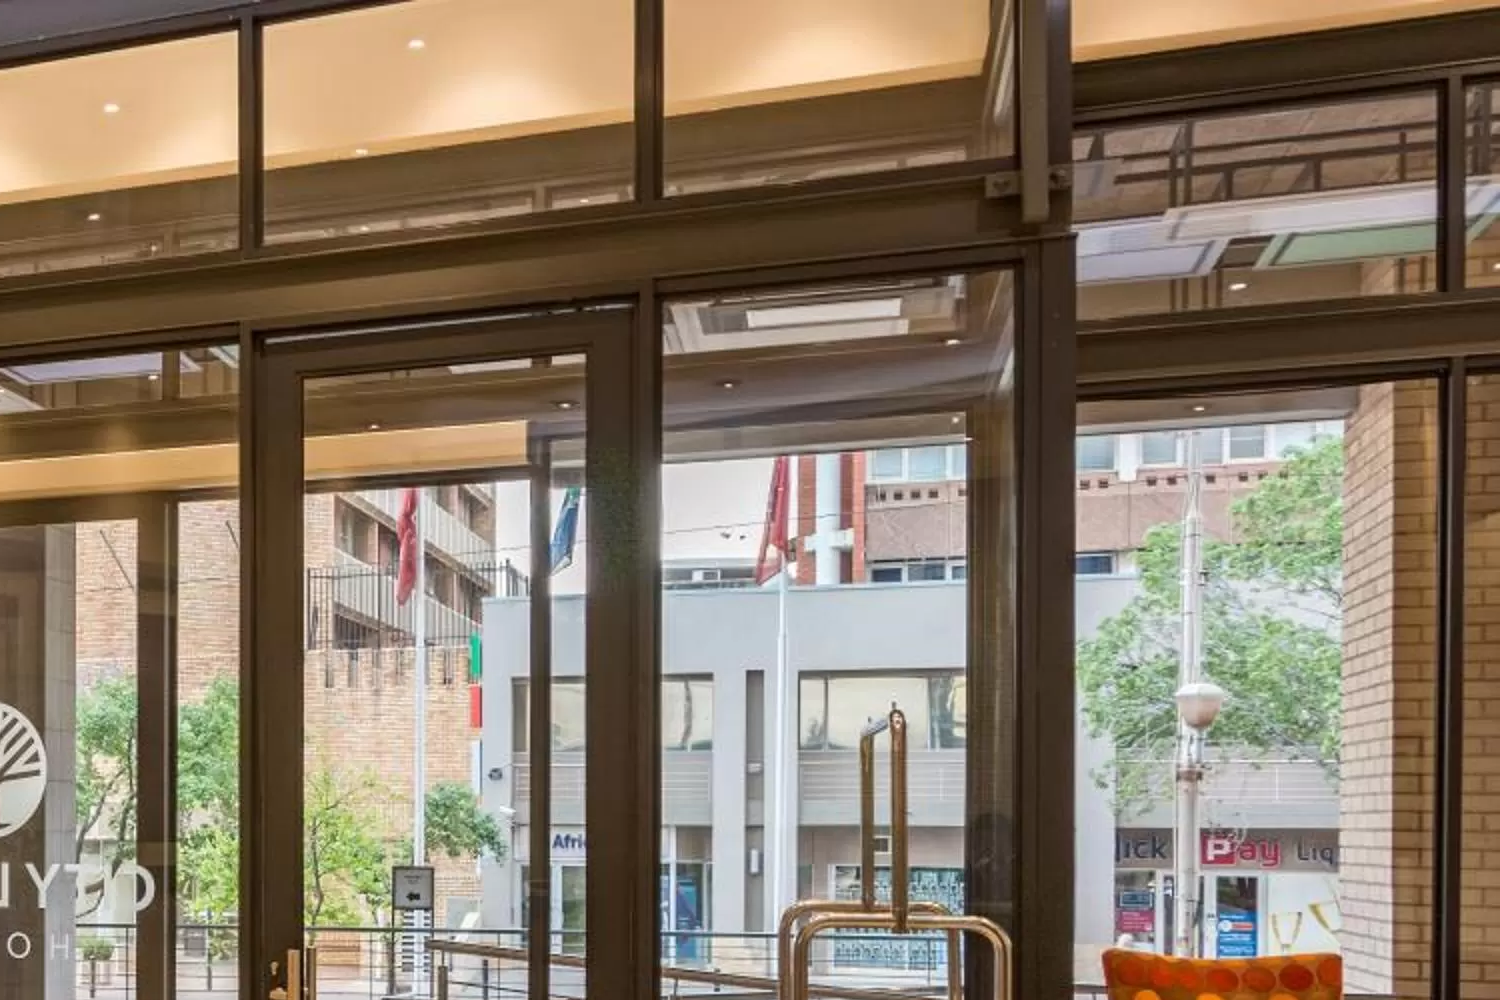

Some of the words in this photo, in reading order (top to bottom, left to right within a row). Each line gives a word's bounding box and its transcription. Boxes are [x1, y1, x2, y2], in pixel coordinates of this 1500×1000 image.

[552, 833, 587, 850] Afri
[1115, 834, 1167, 862] ick
[1203, 835, 1281, 867] Pay
